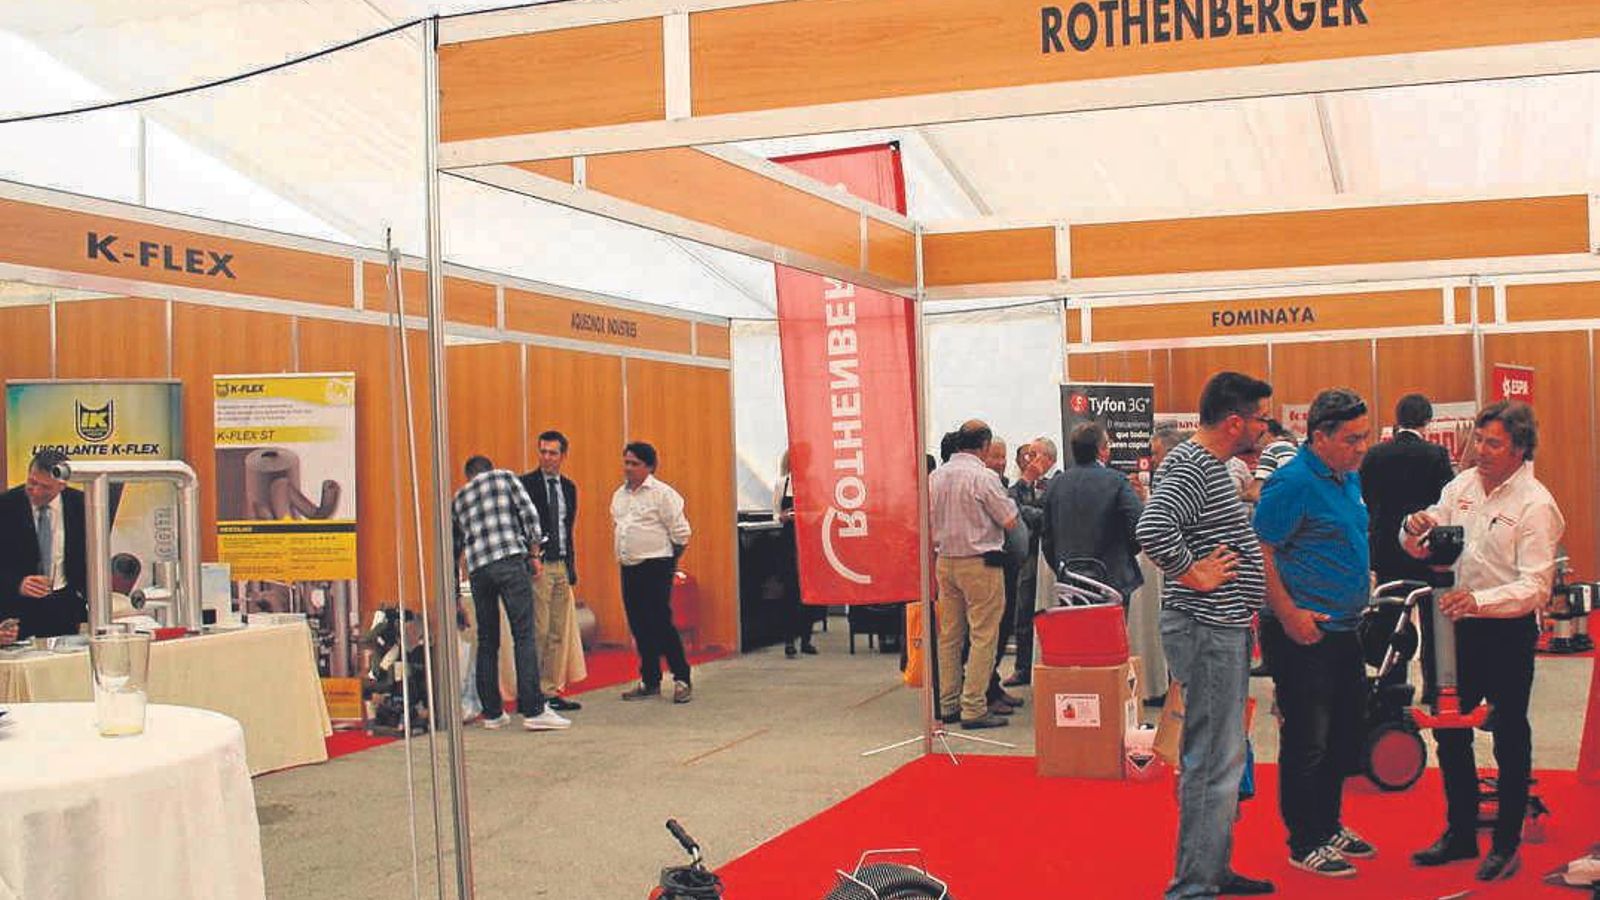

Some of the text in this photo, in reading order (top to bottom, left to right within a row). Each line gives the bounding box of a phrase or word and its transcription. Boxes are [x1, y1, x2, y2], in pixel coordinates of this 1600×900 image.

[1041, 0, 1369, 54] ROTHENBERGER
[86, 231, 236, 279] K-FLEX
[1211, 306, 1315, 327] FOMINAYA
[230, 384, 265, 394] K-FLEX
[1088, 396, 1126, 415] Tyfon
[217, 430, 258, 442] K-FLEX
[1116, 431, 1129, 441] que
[112, 443, 160, 455] K-FLEX
